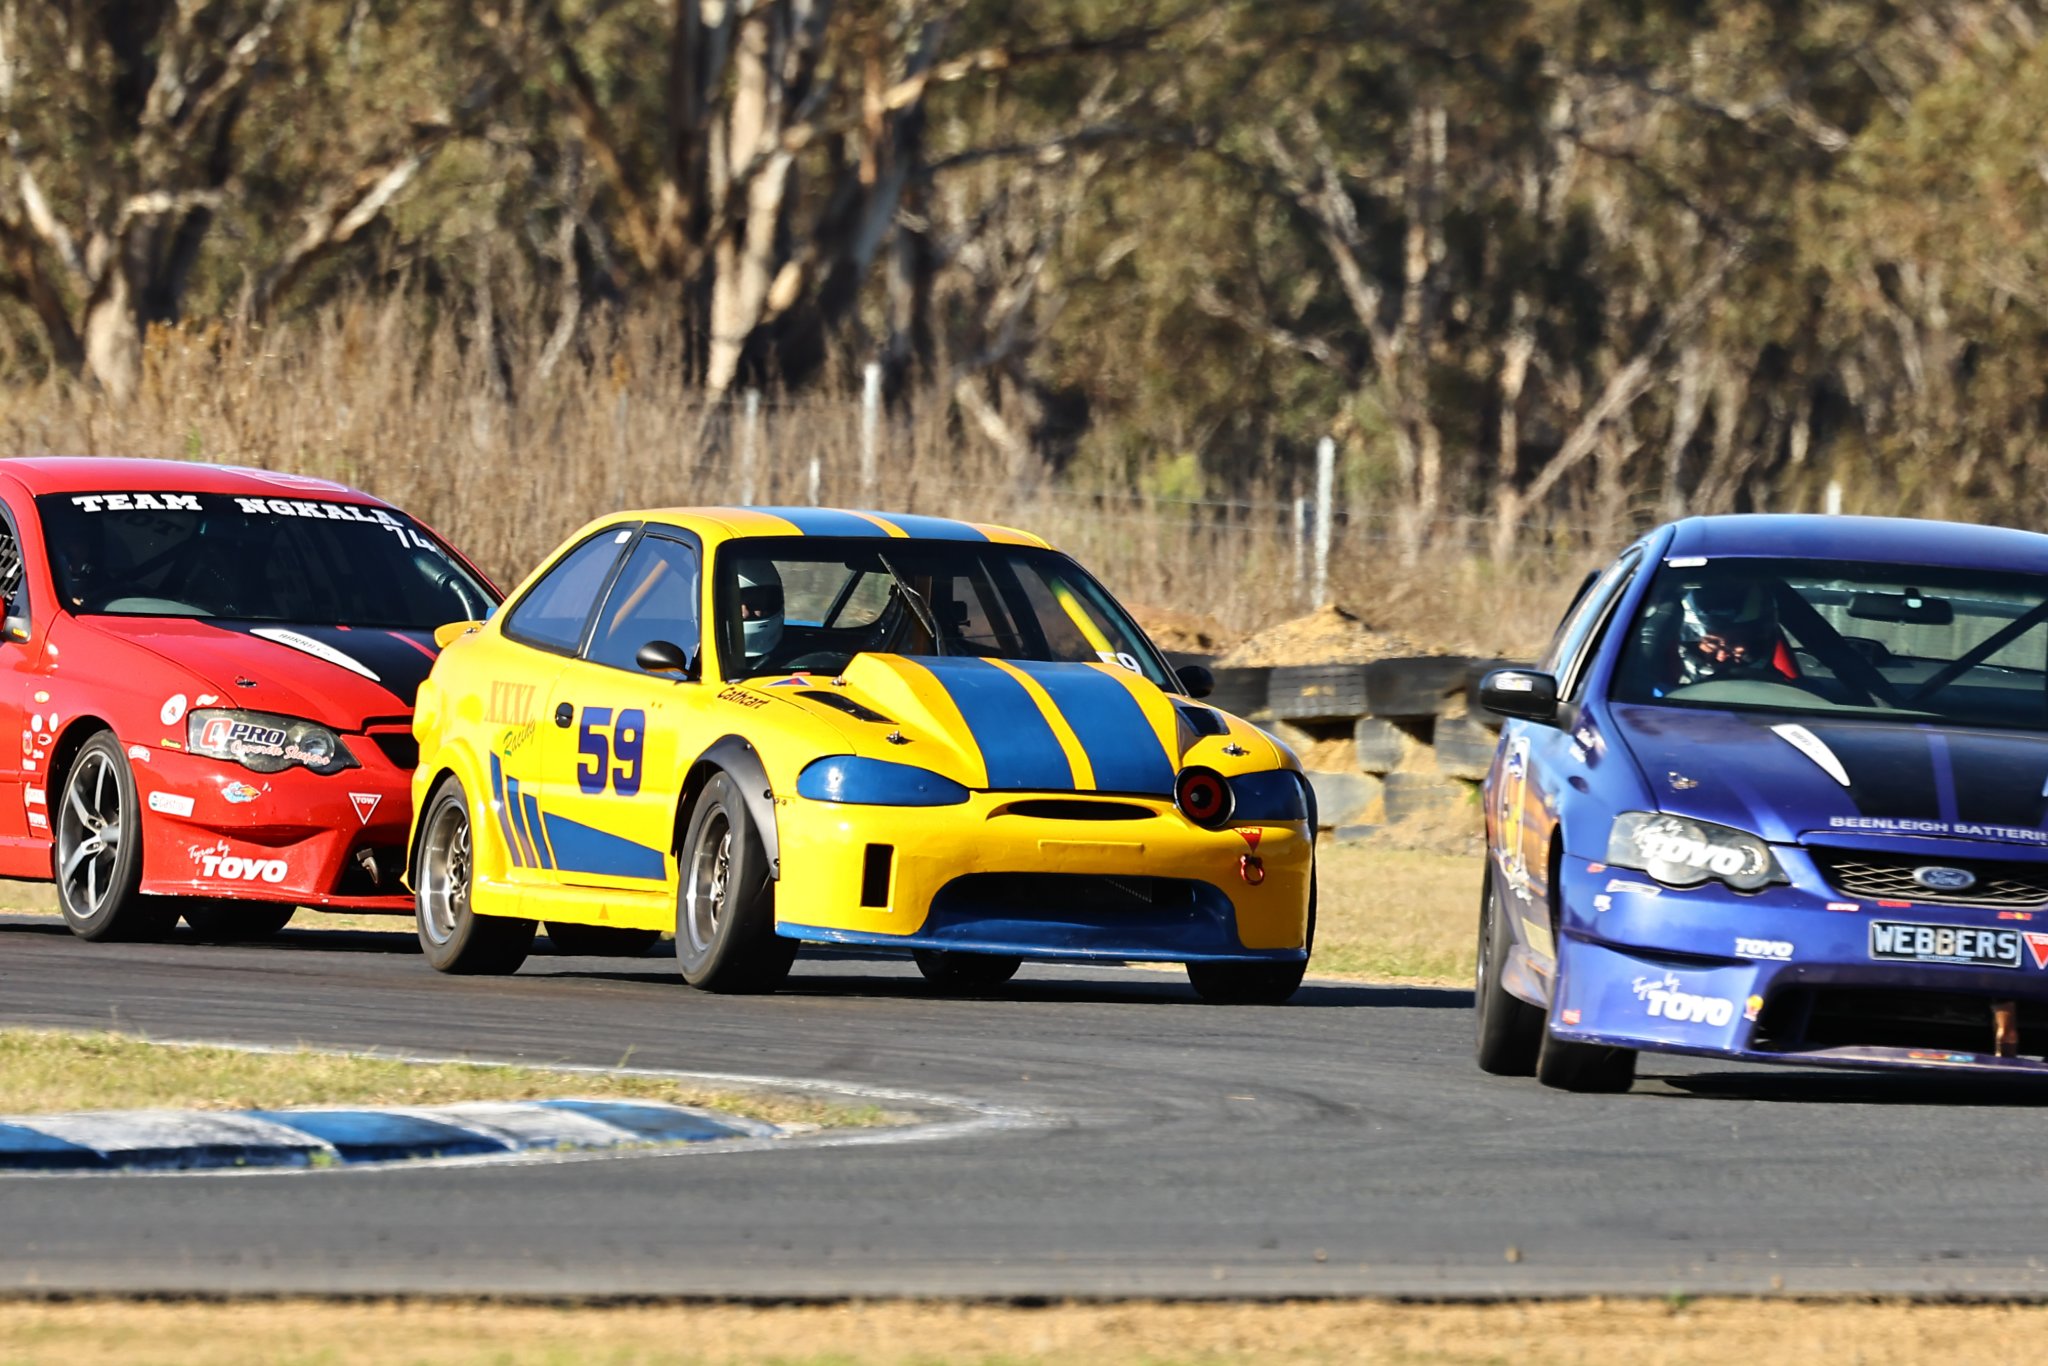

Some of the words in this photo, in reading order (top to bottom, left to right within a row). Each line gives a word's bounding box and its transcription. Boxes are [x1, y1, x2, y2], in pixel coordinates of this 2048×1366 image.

[71, 493, 203, 512] TEAM
[234, 498, 404, 527] NGKALA
[383, 524, 437, 553] 74
[577, 706, 646, 797] 59
[355, 796, 375, 805] TOW
[1829, 816, 1949, 833] BEENLEIGH
[202, 855, 288, 883] TOYO
[1640, 835, 1747, 876] TOYO
[1735, 937, 1794, 957] TOYO
[1873, 923, 2018, 960] WEBBERS
[1647, 990, 1734, 1027] TOYO
